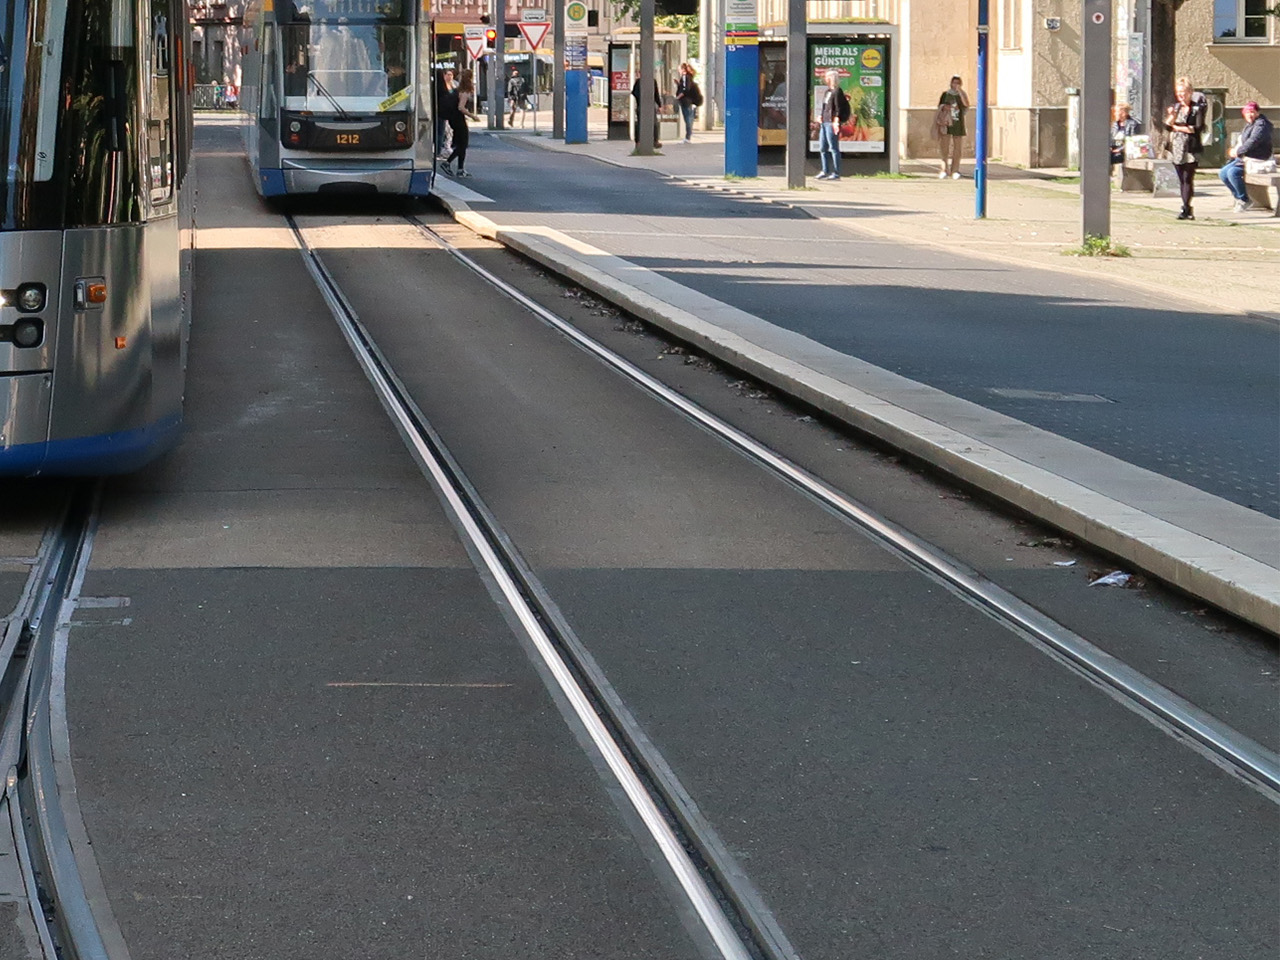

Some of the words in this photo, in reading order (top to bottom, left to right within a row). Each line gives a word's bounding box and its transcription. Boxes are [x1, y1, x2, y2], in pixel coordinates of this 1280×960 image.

[814, 47, 841, 56] MEHR
[842, 47, 858, 56] ALS
[814, 56, 856, 66] GÜNSTIG
[336, 134, 360, 144] 1212
